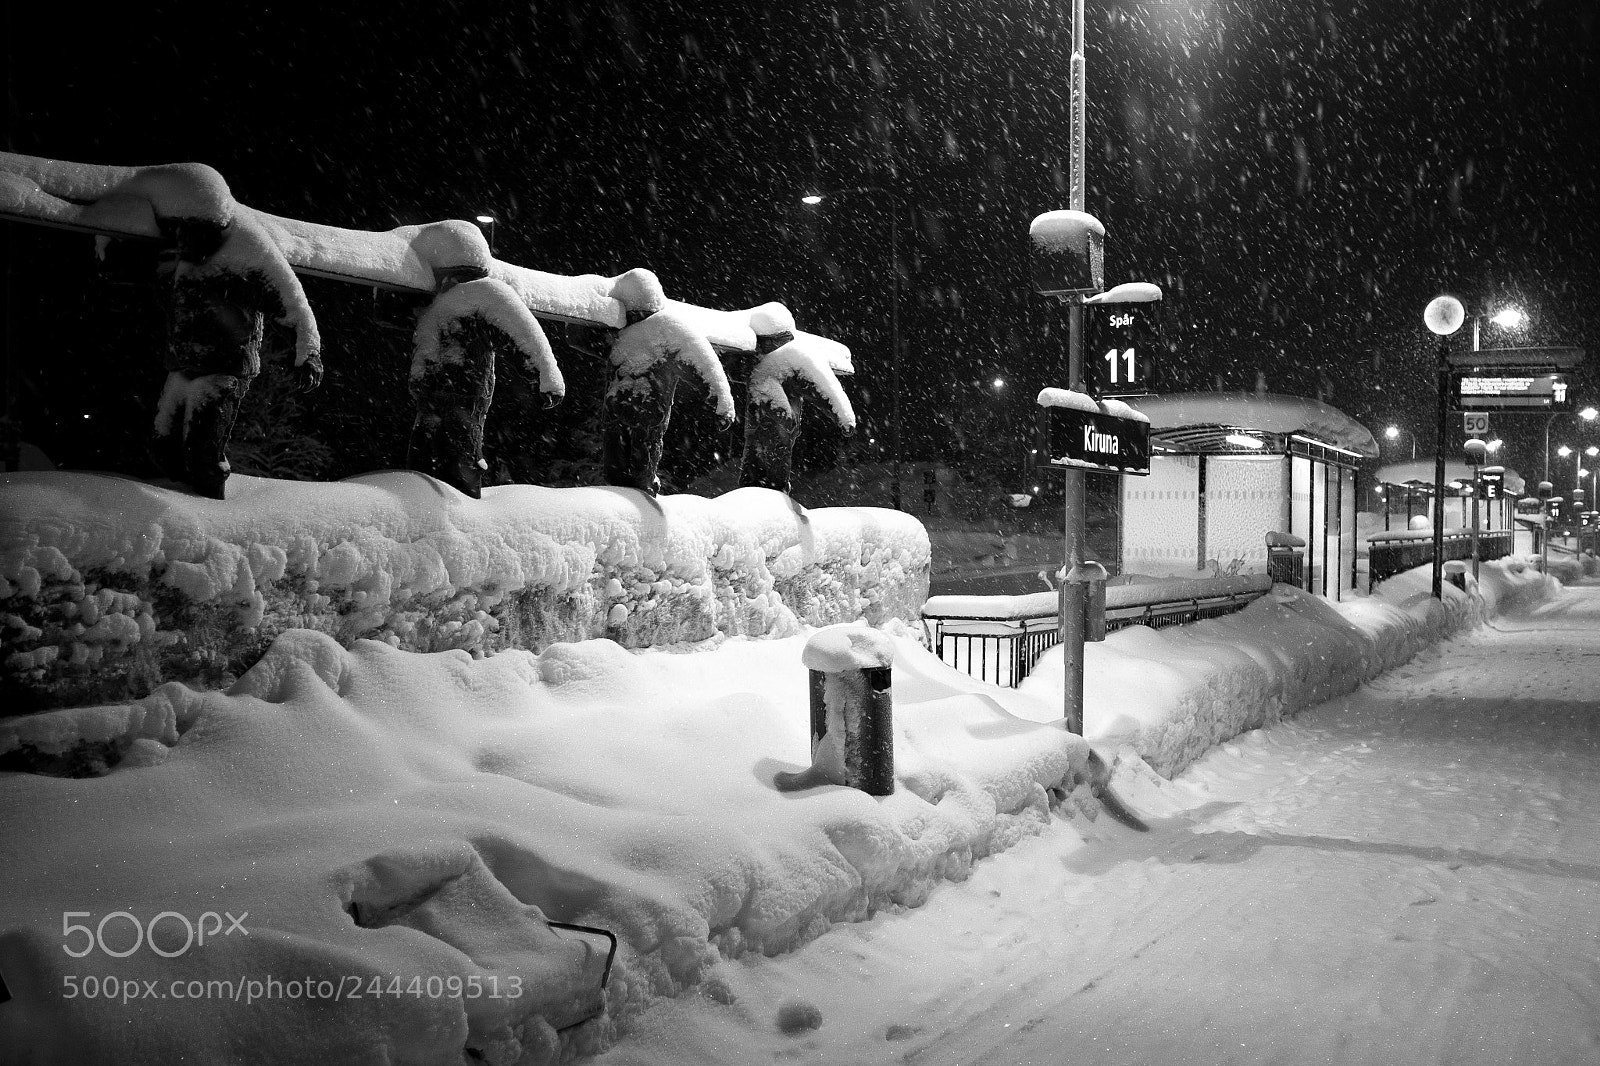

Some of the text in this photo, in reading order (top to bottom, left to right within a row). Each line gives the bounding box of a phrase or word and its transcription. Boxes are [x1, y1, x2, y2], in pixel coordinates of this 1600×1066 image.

[1109, 313, 1134, 328] Spår
[1104, 347, 1135, 384] 11
[1466, 417, 1486, 431] 50
[1084, 424, 1119, 455] Kiruna
[1488, 485, 1495, 497] E
